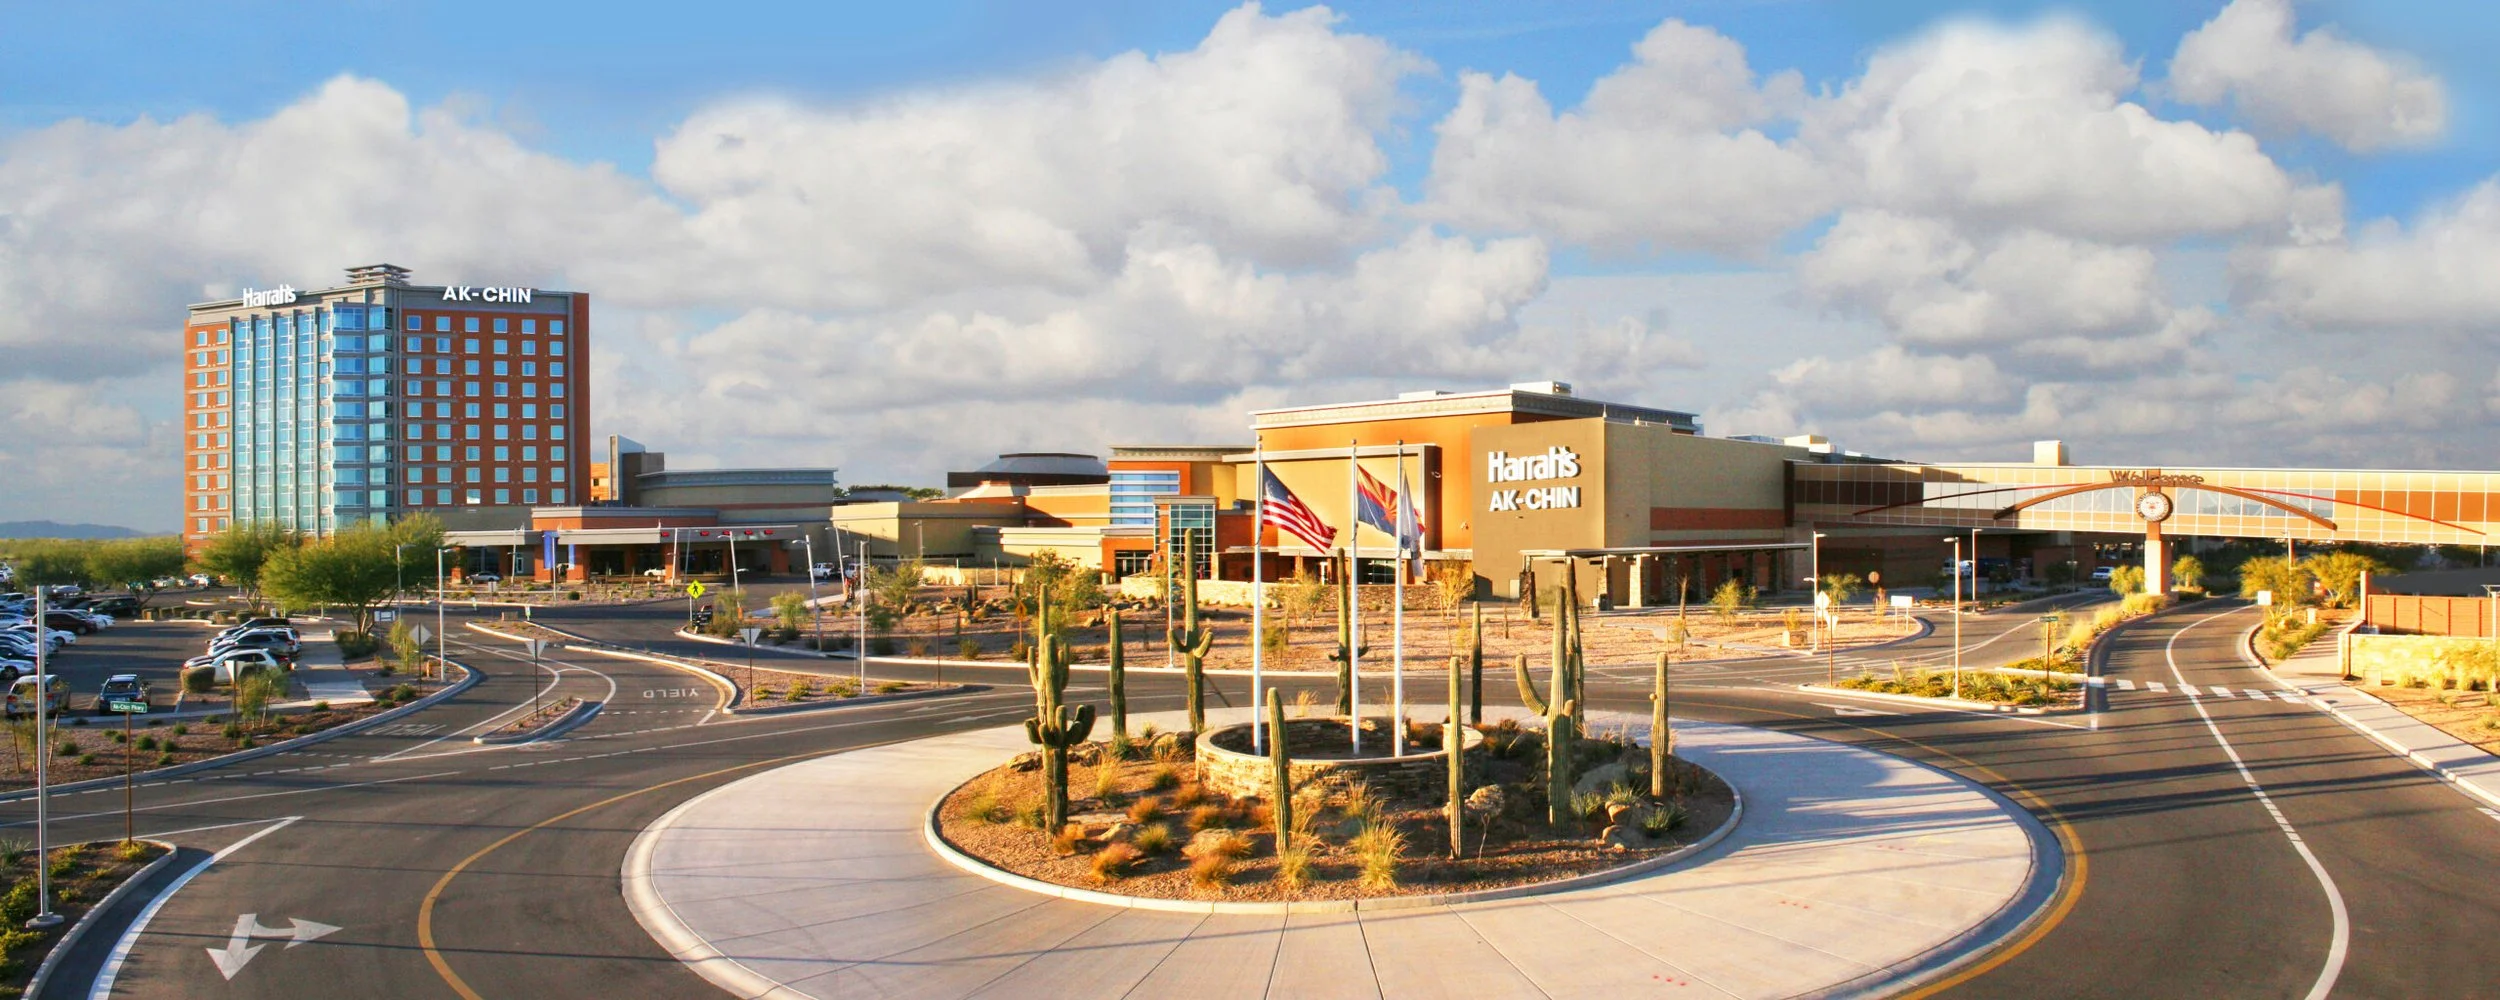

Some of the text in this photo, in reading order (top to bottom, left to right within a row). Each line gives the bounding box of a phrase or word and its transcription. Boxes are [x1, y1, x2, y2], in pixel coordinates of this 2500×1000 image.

[242, 284, 297, 308] Harrah's
[442, 285, 531, 304] AK-CHIN
[1488, 446, 1579, 483] Harrah's
[2109, 470, 2205, 487] Welcome
[1488, 487, 1579, 512] AK-CHIN
[643, 687, 699, 699] YIELD
